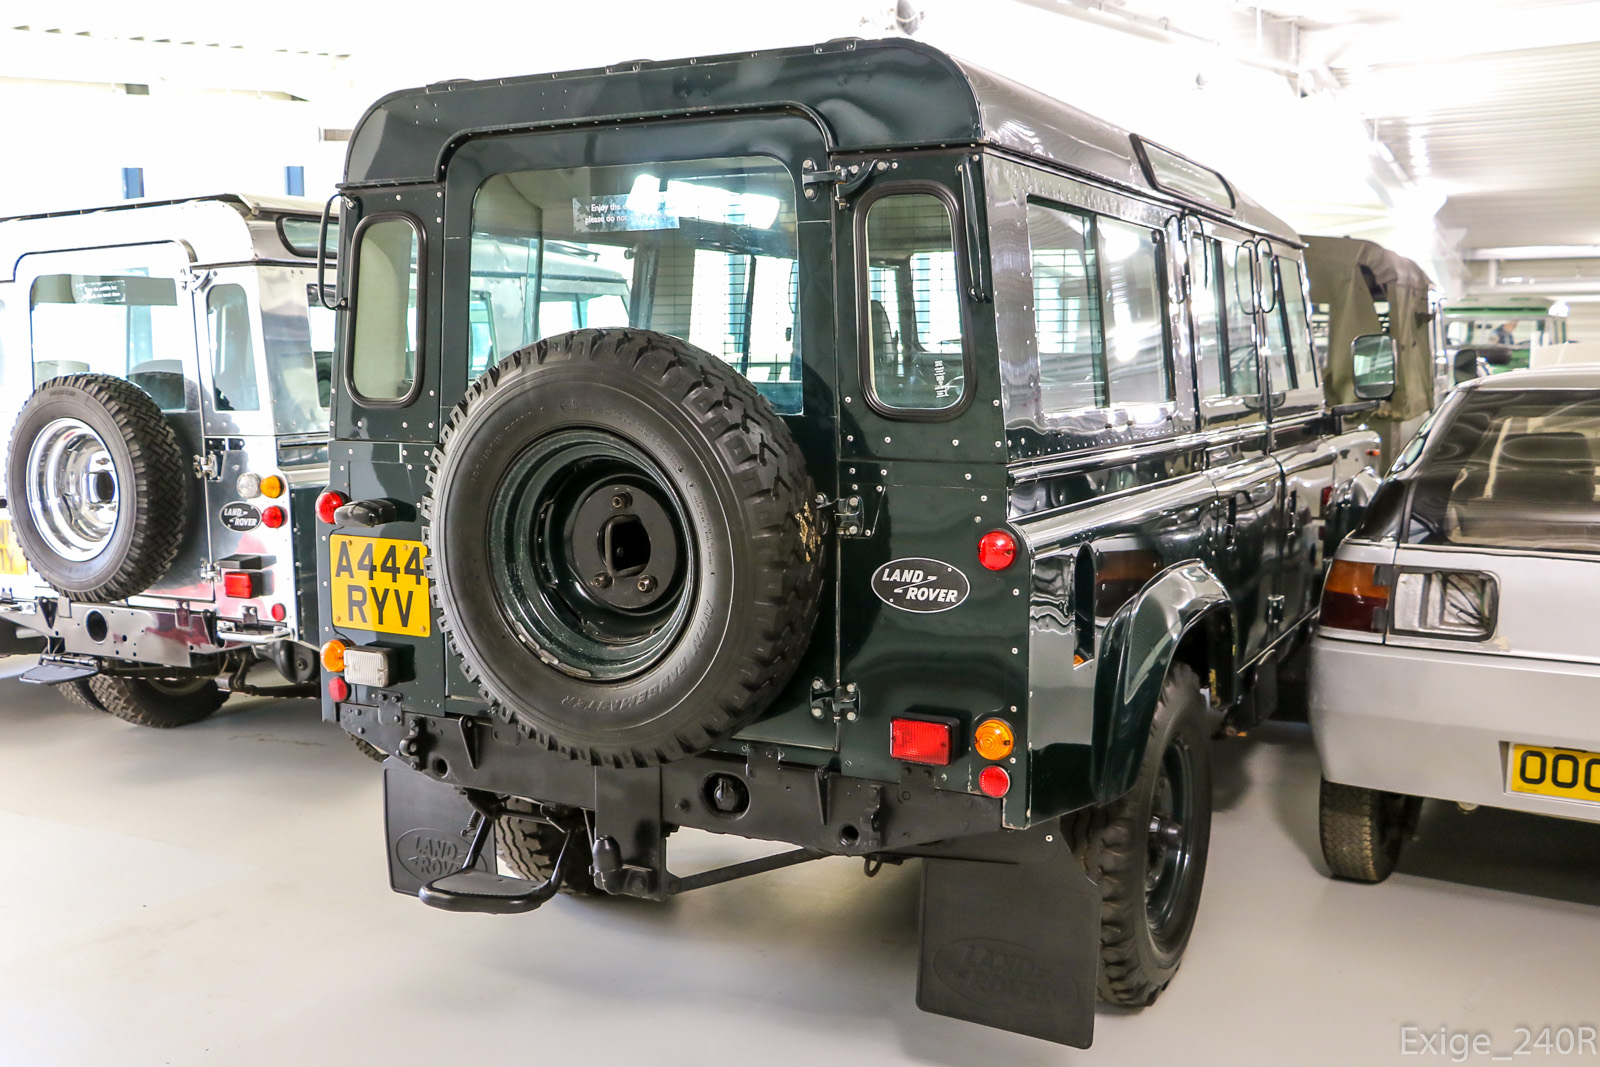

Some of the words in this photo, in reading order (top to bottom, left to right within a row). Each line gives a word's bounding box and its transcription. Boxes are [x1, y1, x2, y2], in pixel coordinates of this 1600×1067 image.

[591, 203, 609, 214] Enjoy
[610, 202, 621, 211] the
[585, 214, 605, 226] please
[606, 213, 615, 223] do
[223, 507, 243, 516] LAND
[234, 517, 258, 527] ROVER
[335, 541, 425, 586] A444
[882, 568, 924, 583] LAND
[905, 587, 958, 603] ROVER
[347, 584, 414, 628] RYV
[415, 836, 458, 860] LAND
